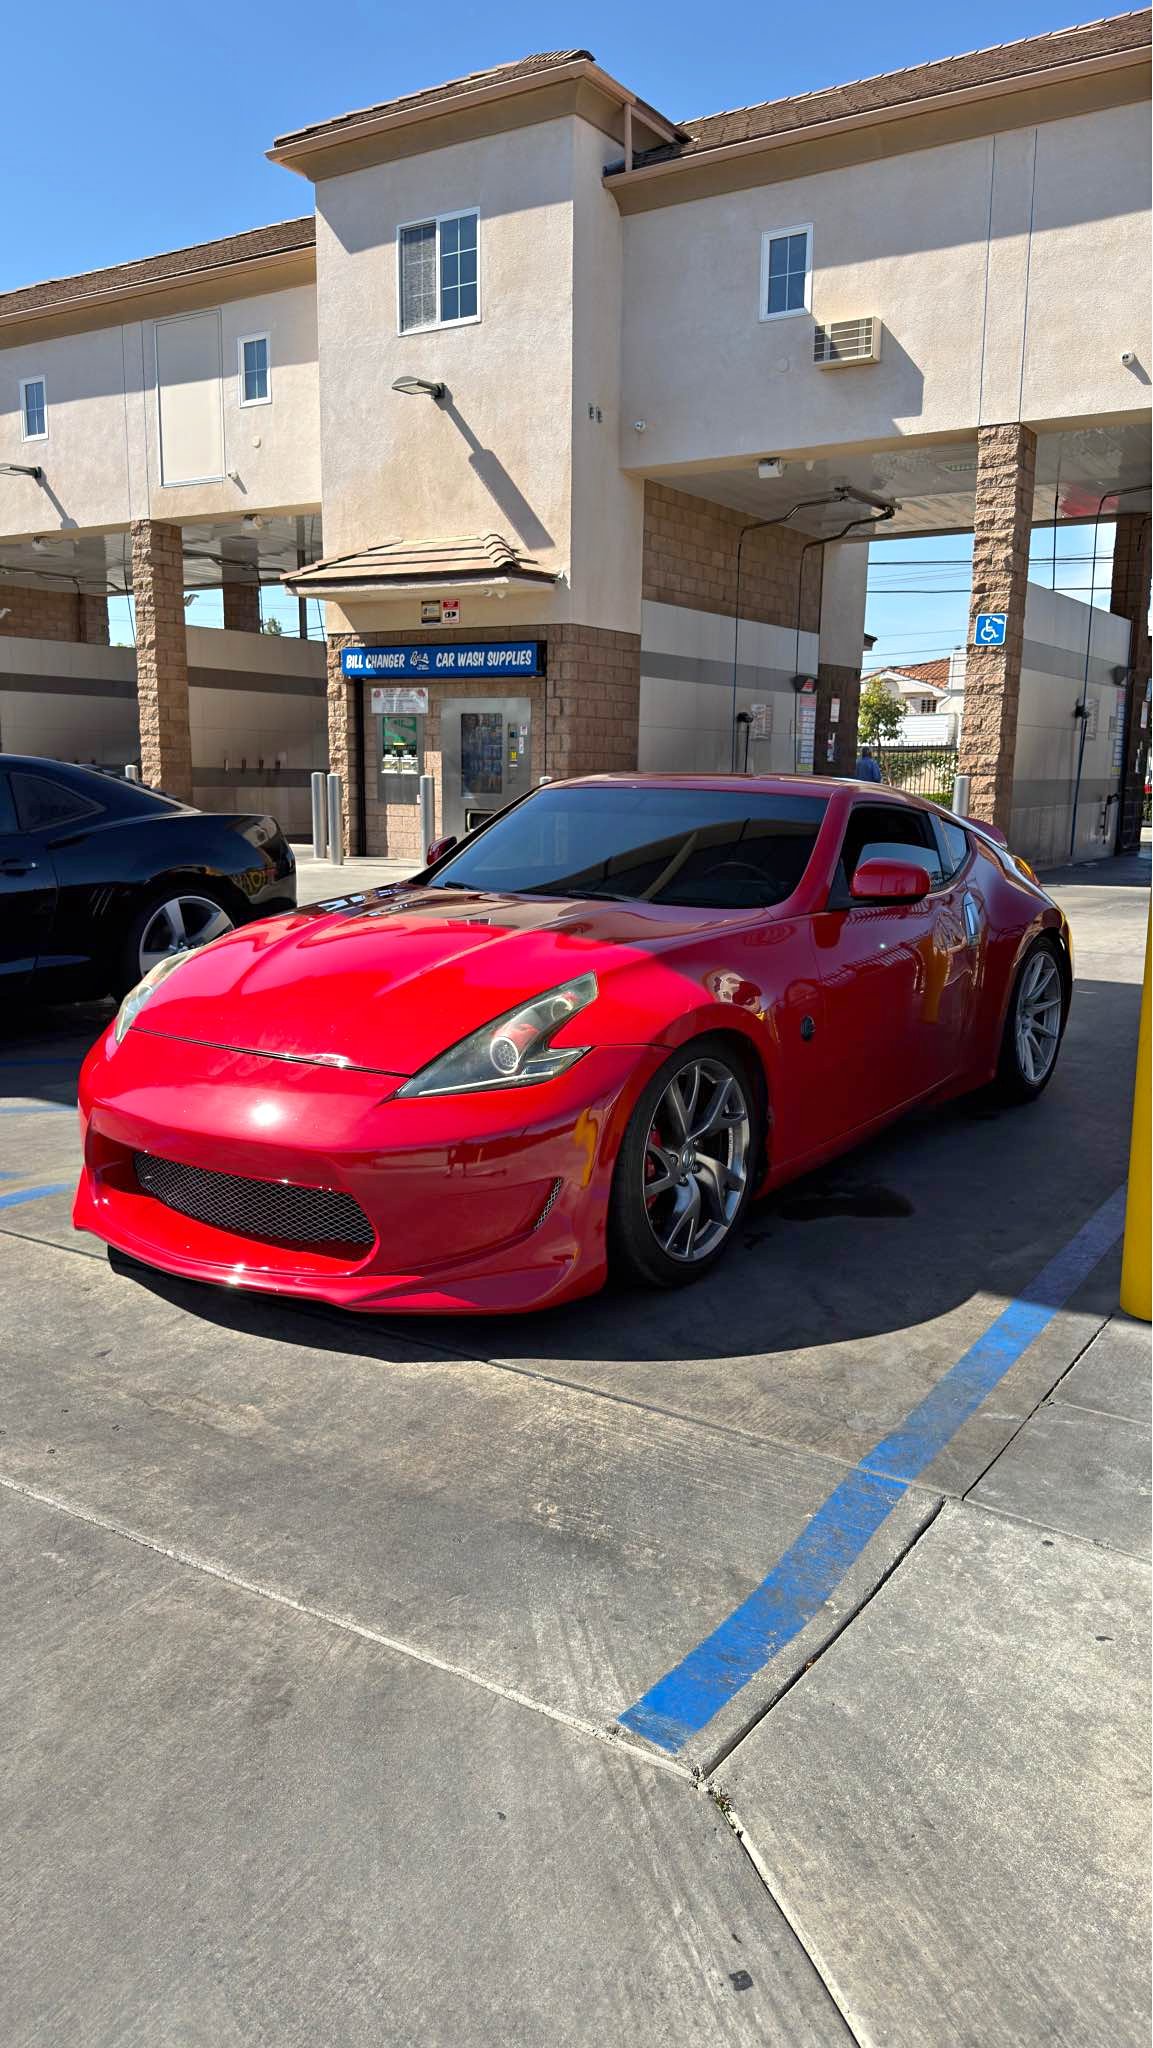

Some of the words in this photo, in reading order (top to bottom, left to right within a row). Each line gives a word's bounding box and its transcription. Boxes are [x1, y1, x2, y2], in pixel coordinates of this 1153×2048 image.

[346, 654, 364, 669] BILL
[365, 653, 405, 669] CHANGER
[436, 652, 455, 667] CAR
[457, 651, 485, 667] WASH
[487, 649, 532, 666] SUPPLIES
